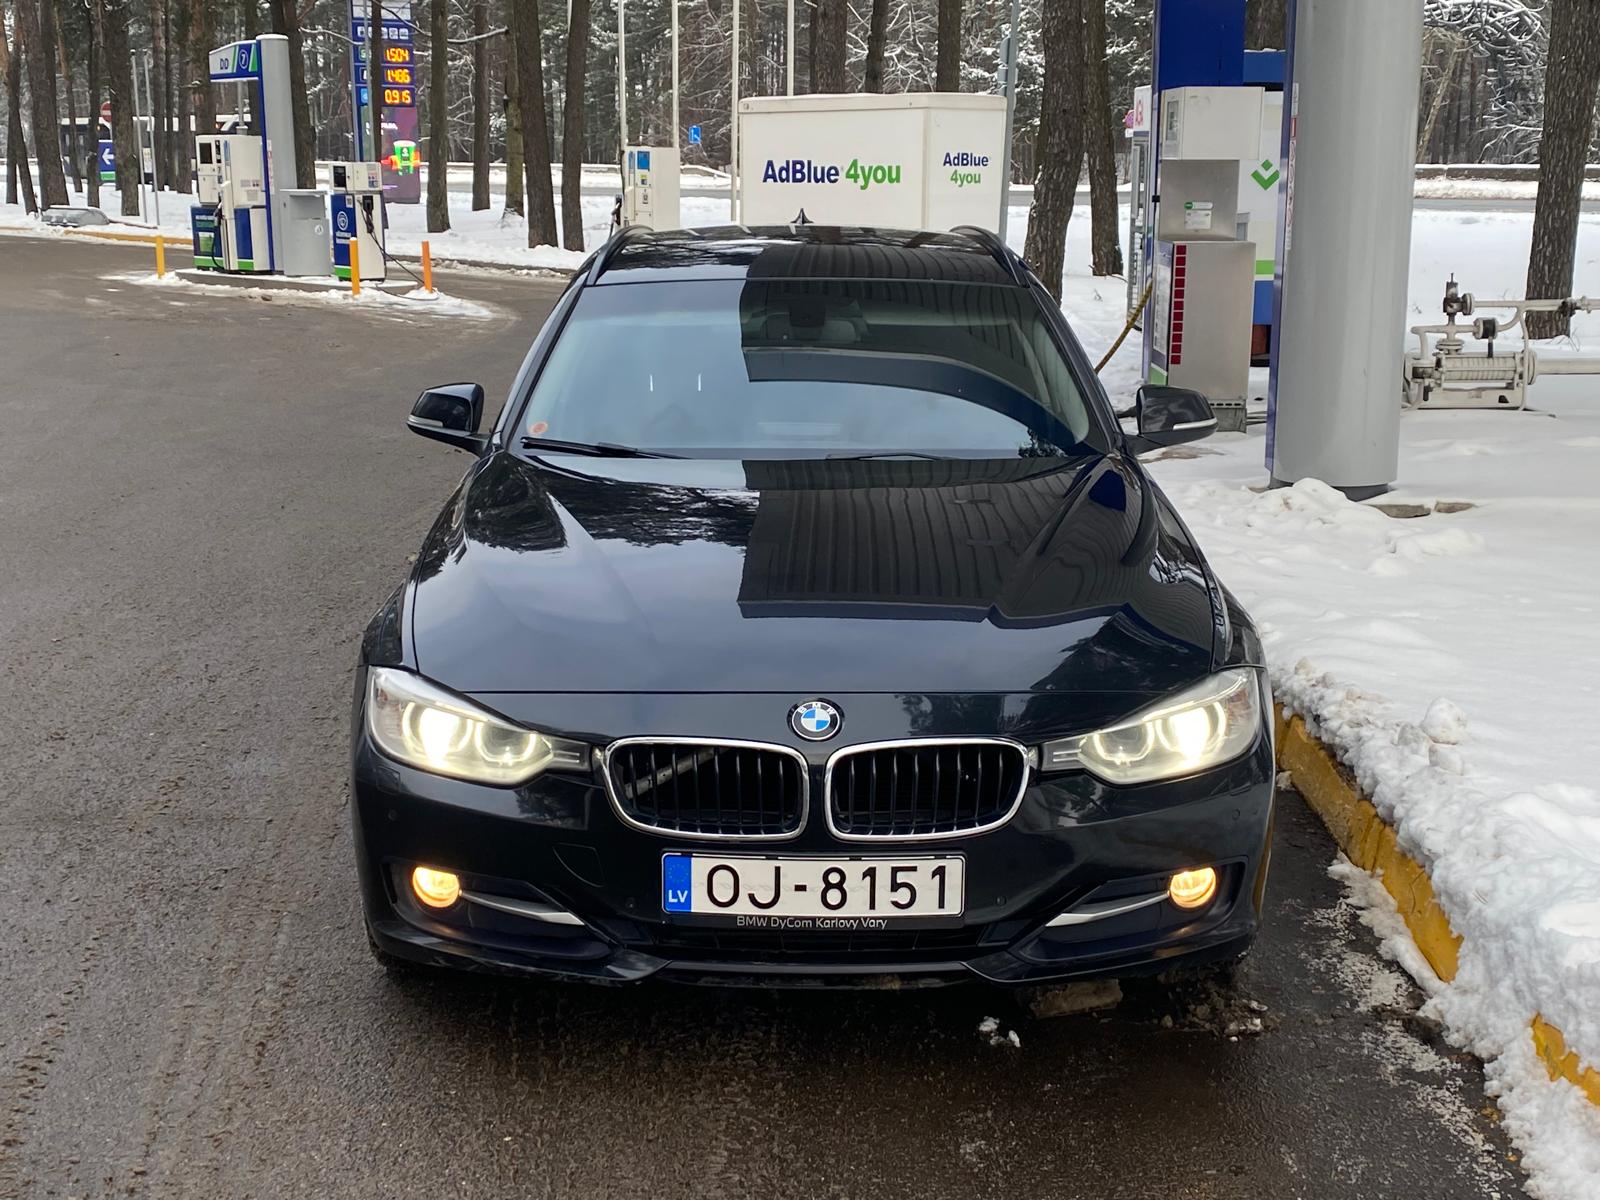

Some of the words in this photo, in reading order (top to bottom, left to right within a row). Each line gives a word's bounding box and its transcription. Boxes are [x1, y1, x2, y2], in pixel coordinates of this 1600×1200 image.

[943, 152, 989, 167] AdBlue
[762, 159, 840, 184] AdBlue
[845, 158, 901, 191] 4you
[950, 169, 982, 188] 4you
[796, 701, 837, 715] BMW
[706, 863, 947, 911] OJ-8151
[668, 889, 688, 904] LV
[736, 915, 768, 927] BMW
[770, 916, 813, 930] DyCom
[815, 917, 859, 930] Karlovy
[861, 917, 888, 930] Vary
